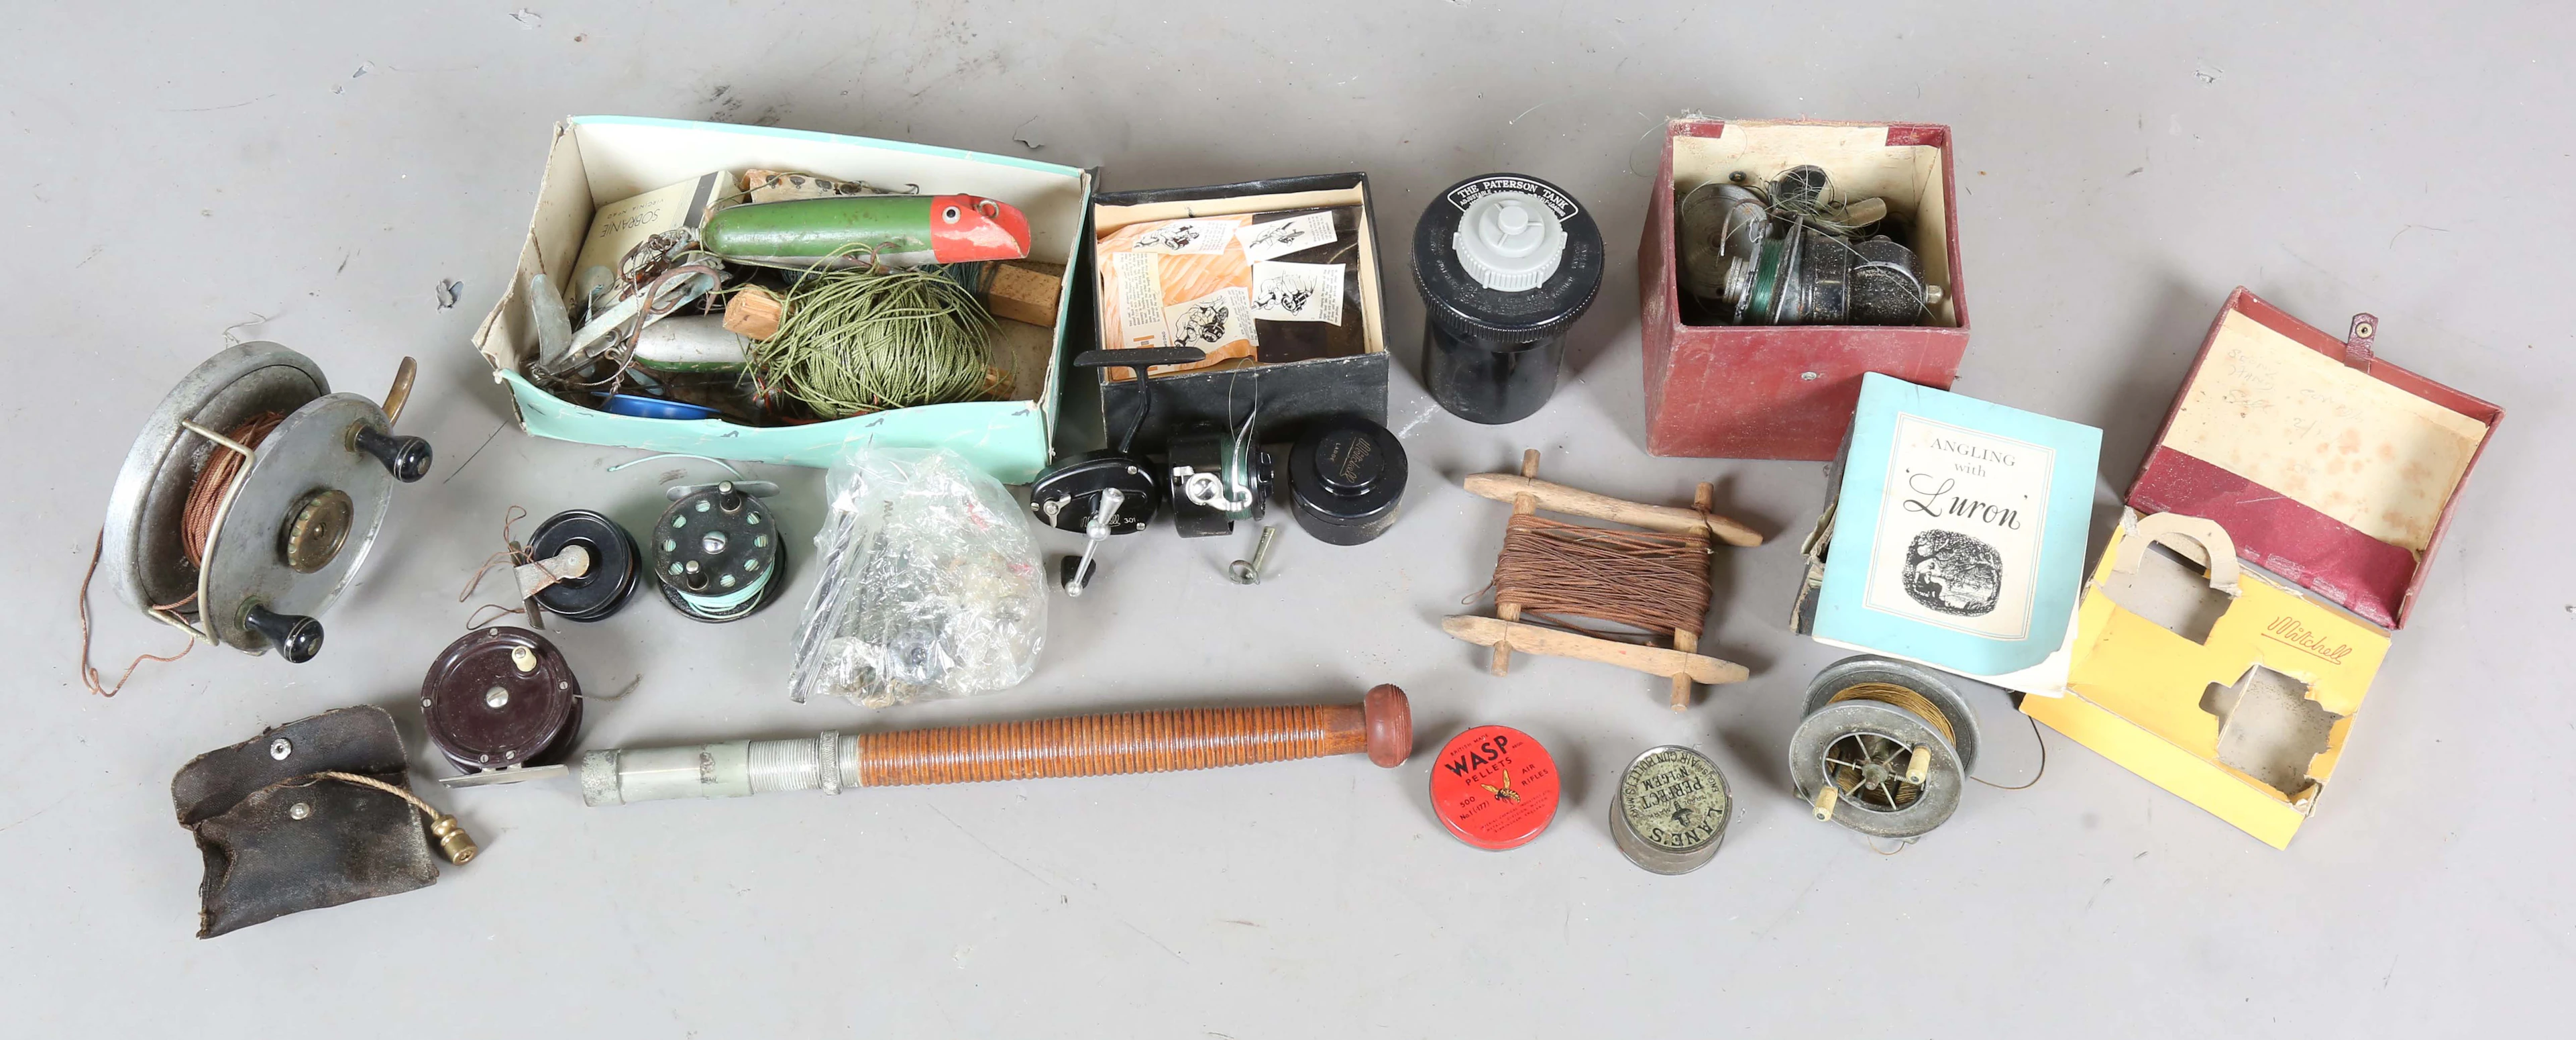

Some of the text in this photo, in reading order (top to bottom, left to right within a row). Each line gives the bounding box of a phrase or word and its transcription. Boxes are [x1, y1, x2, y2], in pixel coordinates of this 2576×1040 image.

[632, 199, 664, 211] VIRGINIA
[1457, 185, 1479, 198] THE
[1483, 180, 1538, 193] PATERSON
[1543, 189, 1568, 209] TANK
[1460, 189, 1493, 206] ADJUSTABLE
[600, 209, 660, 238] SOBRANIE
[1330, 442, 1341, 462] LARGE
[1344, 437, 1371, 483] Mitchell
[1930, 438, 2016, 466] ANGLING
[1954, 462, 1986, 477] with
[2265, 616, 2353, 664] Mitchell
[1444, 735, 1508, 777] WASP
[1450, 733, 1489, 756] BRITISH MADE
[1465, 757, 1512, 786] PELLETS
[1521, 769, 1548, 786] RIFLES
[1522, 764, 1536, 774] AIR
[1642, 773, 1670, 790] GEM
[1625, 751, 1719, 820] ENGLISH AIR GUN BULLETS MAKE
[1640, 776, 1704, 810] PERFECT
[1460, 796, 1476, 808] 500
[1650, 796, 1707, 819] TRADE MARK
[1648, 807, 1723, 847] LANE'S
